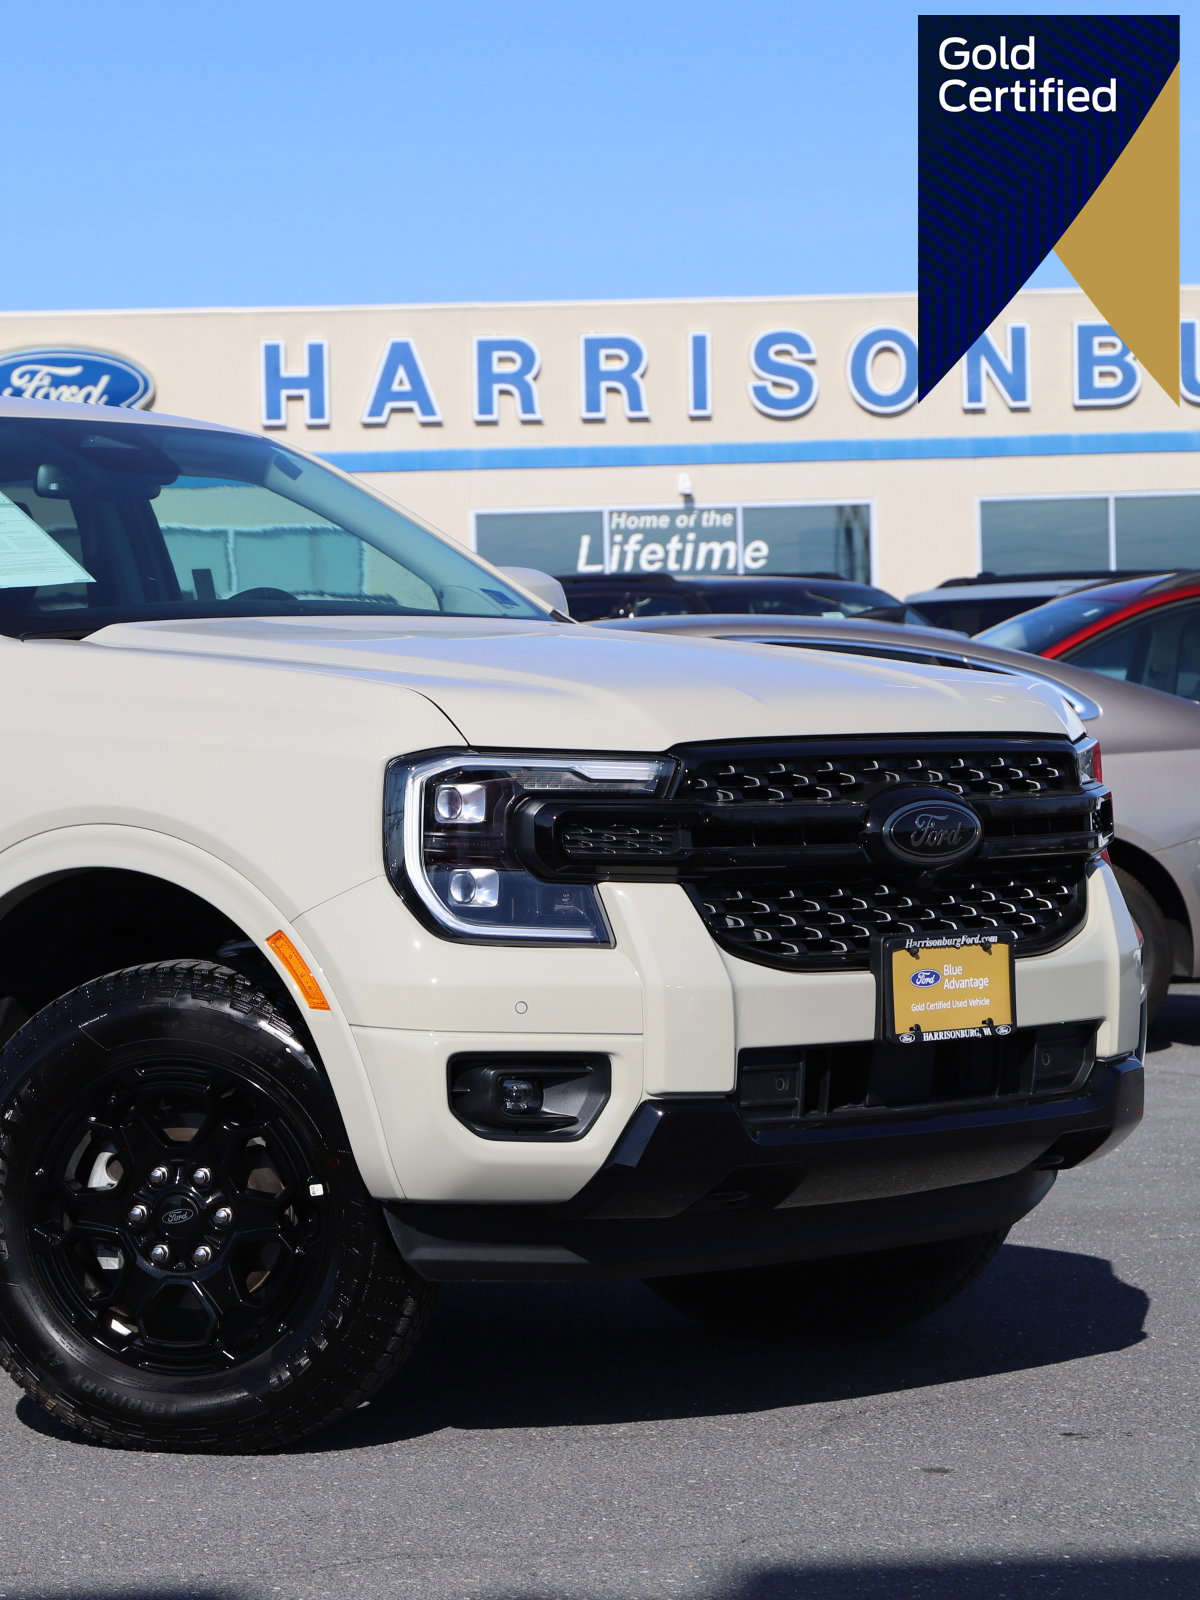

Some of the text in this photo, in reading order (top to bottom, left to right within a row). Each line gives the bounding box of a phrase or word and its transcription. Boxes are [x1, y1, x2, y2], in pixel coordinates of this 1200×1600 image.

[1, 364, 112, 405] Ford
[610, 510, 735, 530] Home of the
[576, 532, 770, 573] Lifetime
[910, 813, 962, 847] Ford
[943, 964, 963, 976] Blue
[943, 977, 989, 990] Advantage
[911, 997, 990, 1012] Gold Certified Used Vehicle
[983, 1027, 992, 1036] VA
